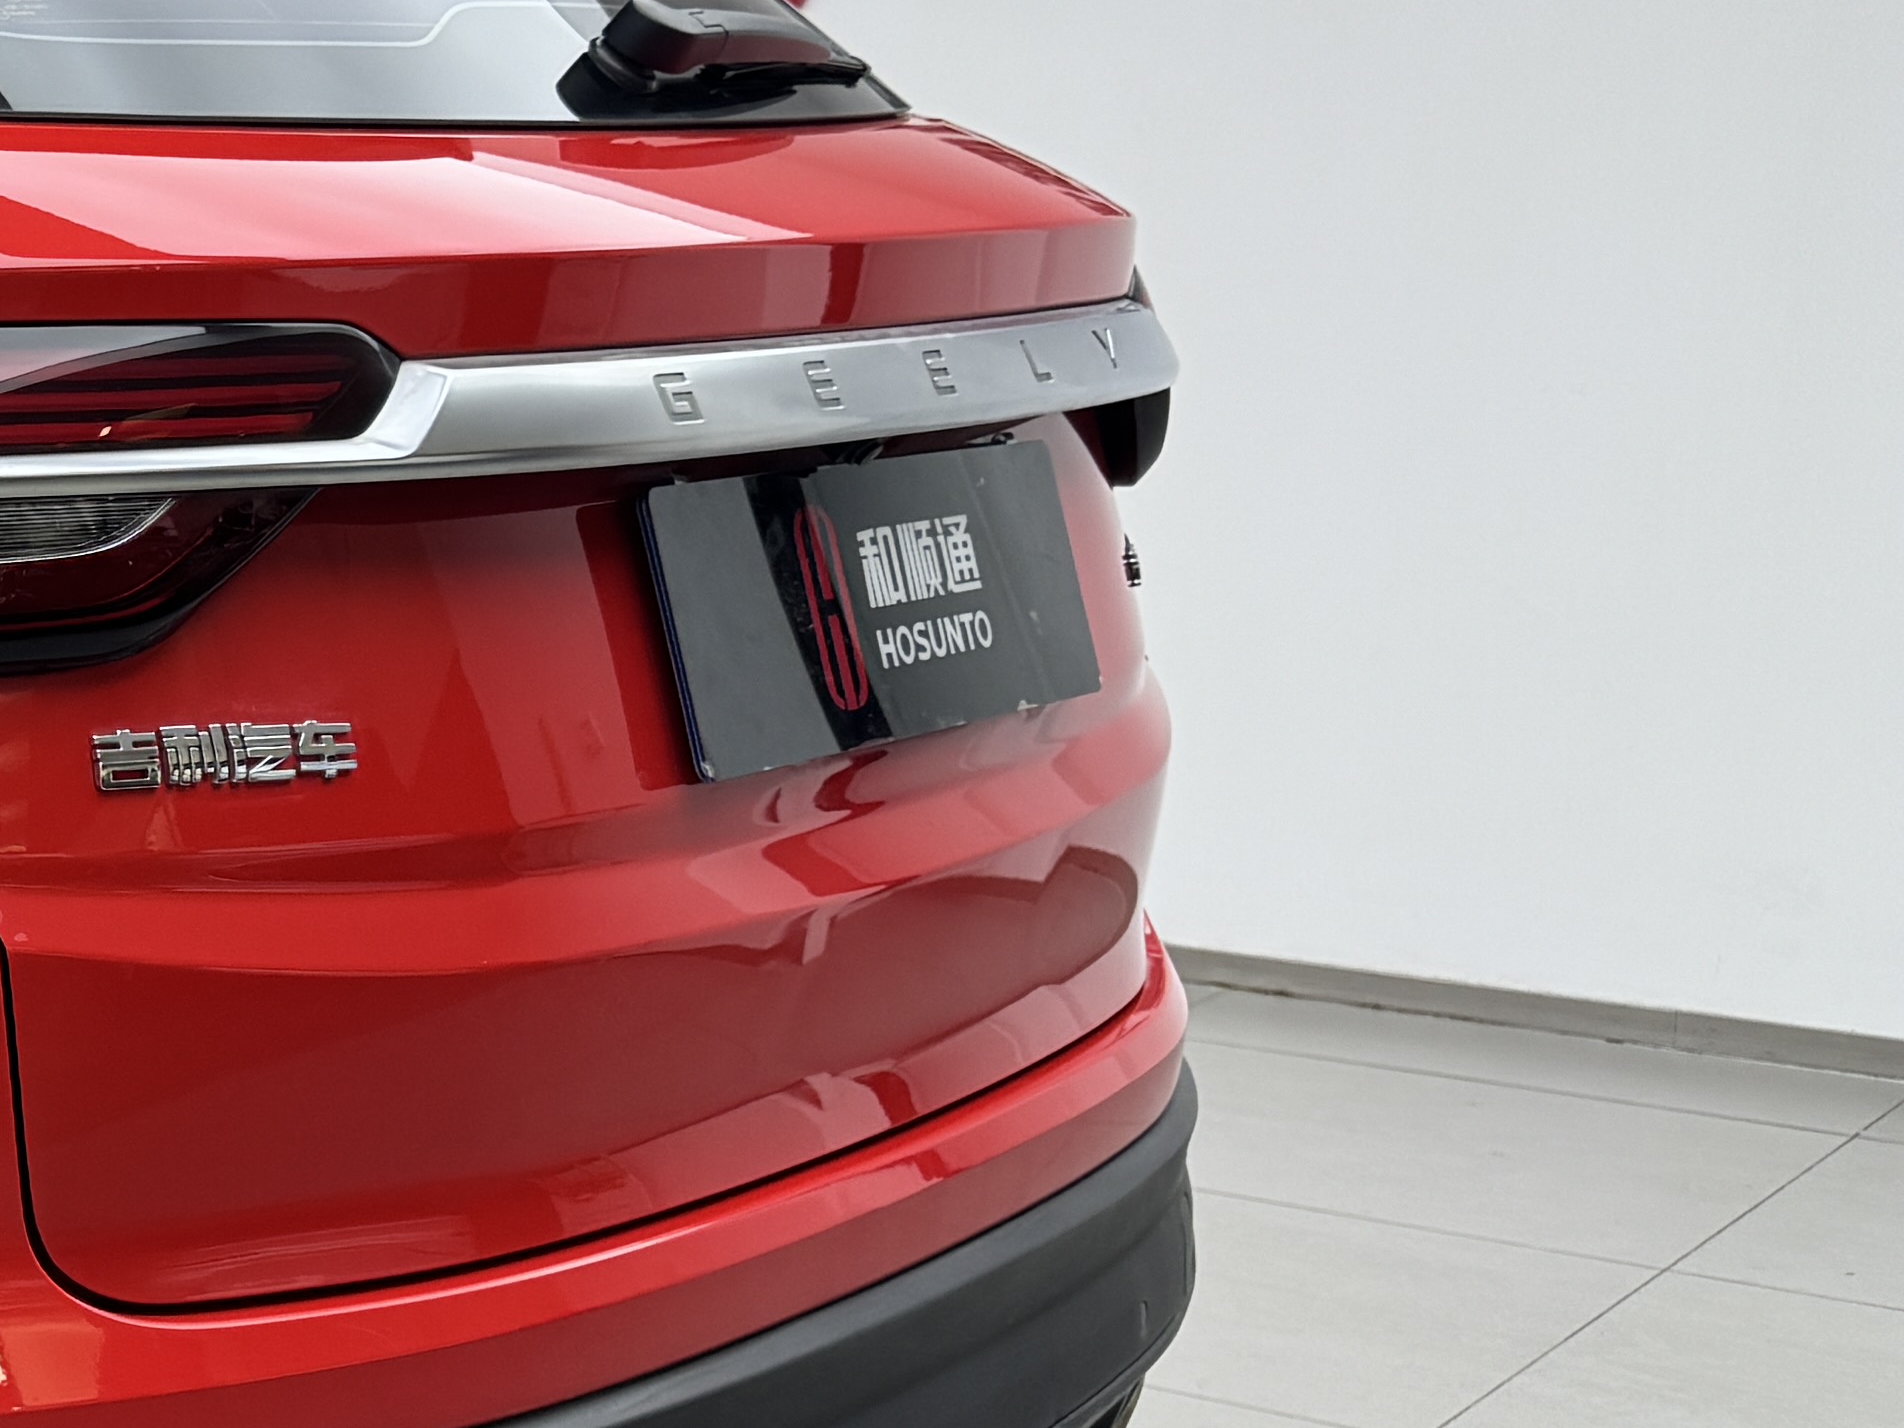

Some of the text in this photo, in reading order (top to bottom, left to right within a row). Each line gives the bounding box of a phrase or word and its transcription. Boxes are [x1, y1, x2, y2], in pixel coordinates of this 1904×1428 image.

[651, 326, 1120, 425] GEELY
[856, 514, 983, 609] 和顺通
[875, 609, 993, 669] HOSUNTO
[92, 719, 359, 791] 吉利汽车
